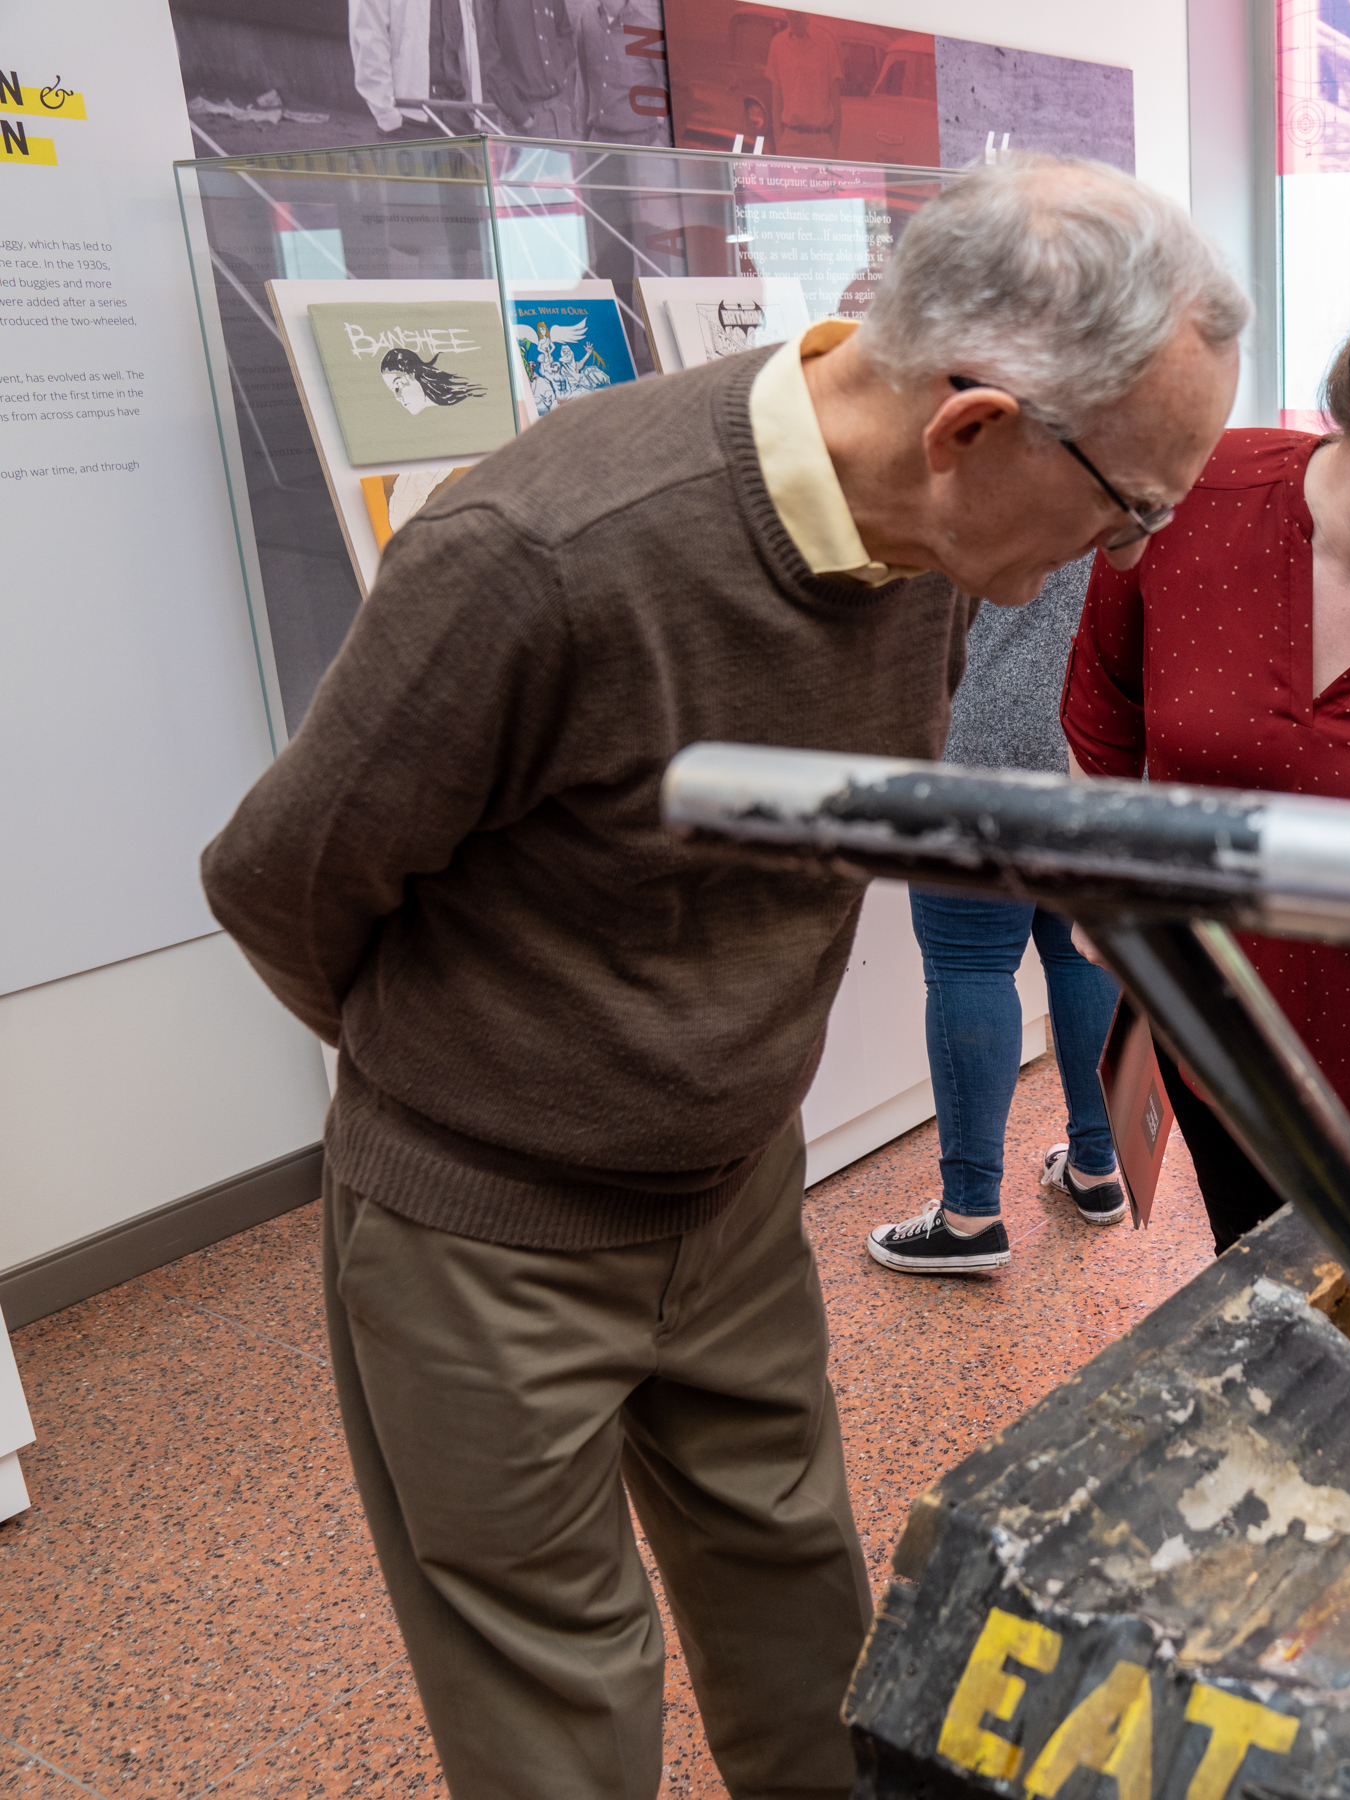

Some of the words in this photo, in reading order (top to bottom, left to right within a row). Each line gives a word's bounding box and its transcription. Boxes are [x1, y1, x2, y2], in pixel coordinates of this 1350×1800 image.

[40, 75, 74, 109] &
[761, 210, 767, 219] a
[769, 207, 810, 221] mechanic
[812, 213, 838, 223] means
[840, 210, 863, 226] being
[865, 212, 882, 224] able
[882, 215, 891, 225] to
[28, 239, 60, 250] which
[62, 240, 82, 251] has
[83, 241, 99, 252] led
[101, 242, 112, 252] to
[761, 231, 773, 240] on
[775, 230, 796, 244] your
[832, 231, 875, 247] something
[876, 235, 894, 247] goes
[15, 260, 42, 269] race.
[44, 259, 55, 269] In
[56, 259, 75, 270] the
[77, 260, 111, 271] 1930s,
[770, 252, 779, 261] as
[780, 248, 798, 261] well
[800, 252, 809, 262] as
[810, 248, 834, 266] being
[835, 250, 852, 262] able
[853, 252, 863, 262] to
[865, 250, 875, 263] fix
[876, 250, 883, 263] it
[815, 271, 825, 281] to
[826, 267, 850, 284] figure
[852, 271, 866, 281] out
[18, 277, 61, 291] buggies
[63, 279, 83, 289] and
[85, 280, 112, 289] more
[26, 297, 60, 308] added
[62, 297, 87, 308] after
[89, 299, 96, 308] a
[97, 298, 128, 308] series
[819, 288, 853, 304] happens
[51, 316, 69, 326] the
[70, 316, 138, 327] two-wheeled,
[721, 309, 763, 325] BATMAN
[343, 322, 482, 360] BANSHEE
[25, 373, 46, 384] has
[47, 371, 87, 383] evolved
[88, 373, 101, 382] as
[102, 370, 125, 381] well.
[125, 370, 145, 380] The
[32, 391, 48, 403] for
[50, 391, 68, 402] the
[70, 390, 91, 401] first
[91, 389, 115, 400] time
[116, 389, 126, 399] in
[127, 388, 144, 398] the
[11, 411, 38, 422] from
[40, 411, 74, 421] across
[75, 408, 116, 420] campus
[116, 407, 141, 417] have
[30, 467, 49, 478] war
[51, 465, 78, 475] time,
[79, 462, 99, 474] and
[100, 459, 141, 472] through
[937, 1606, 1300, 1800] EAT
